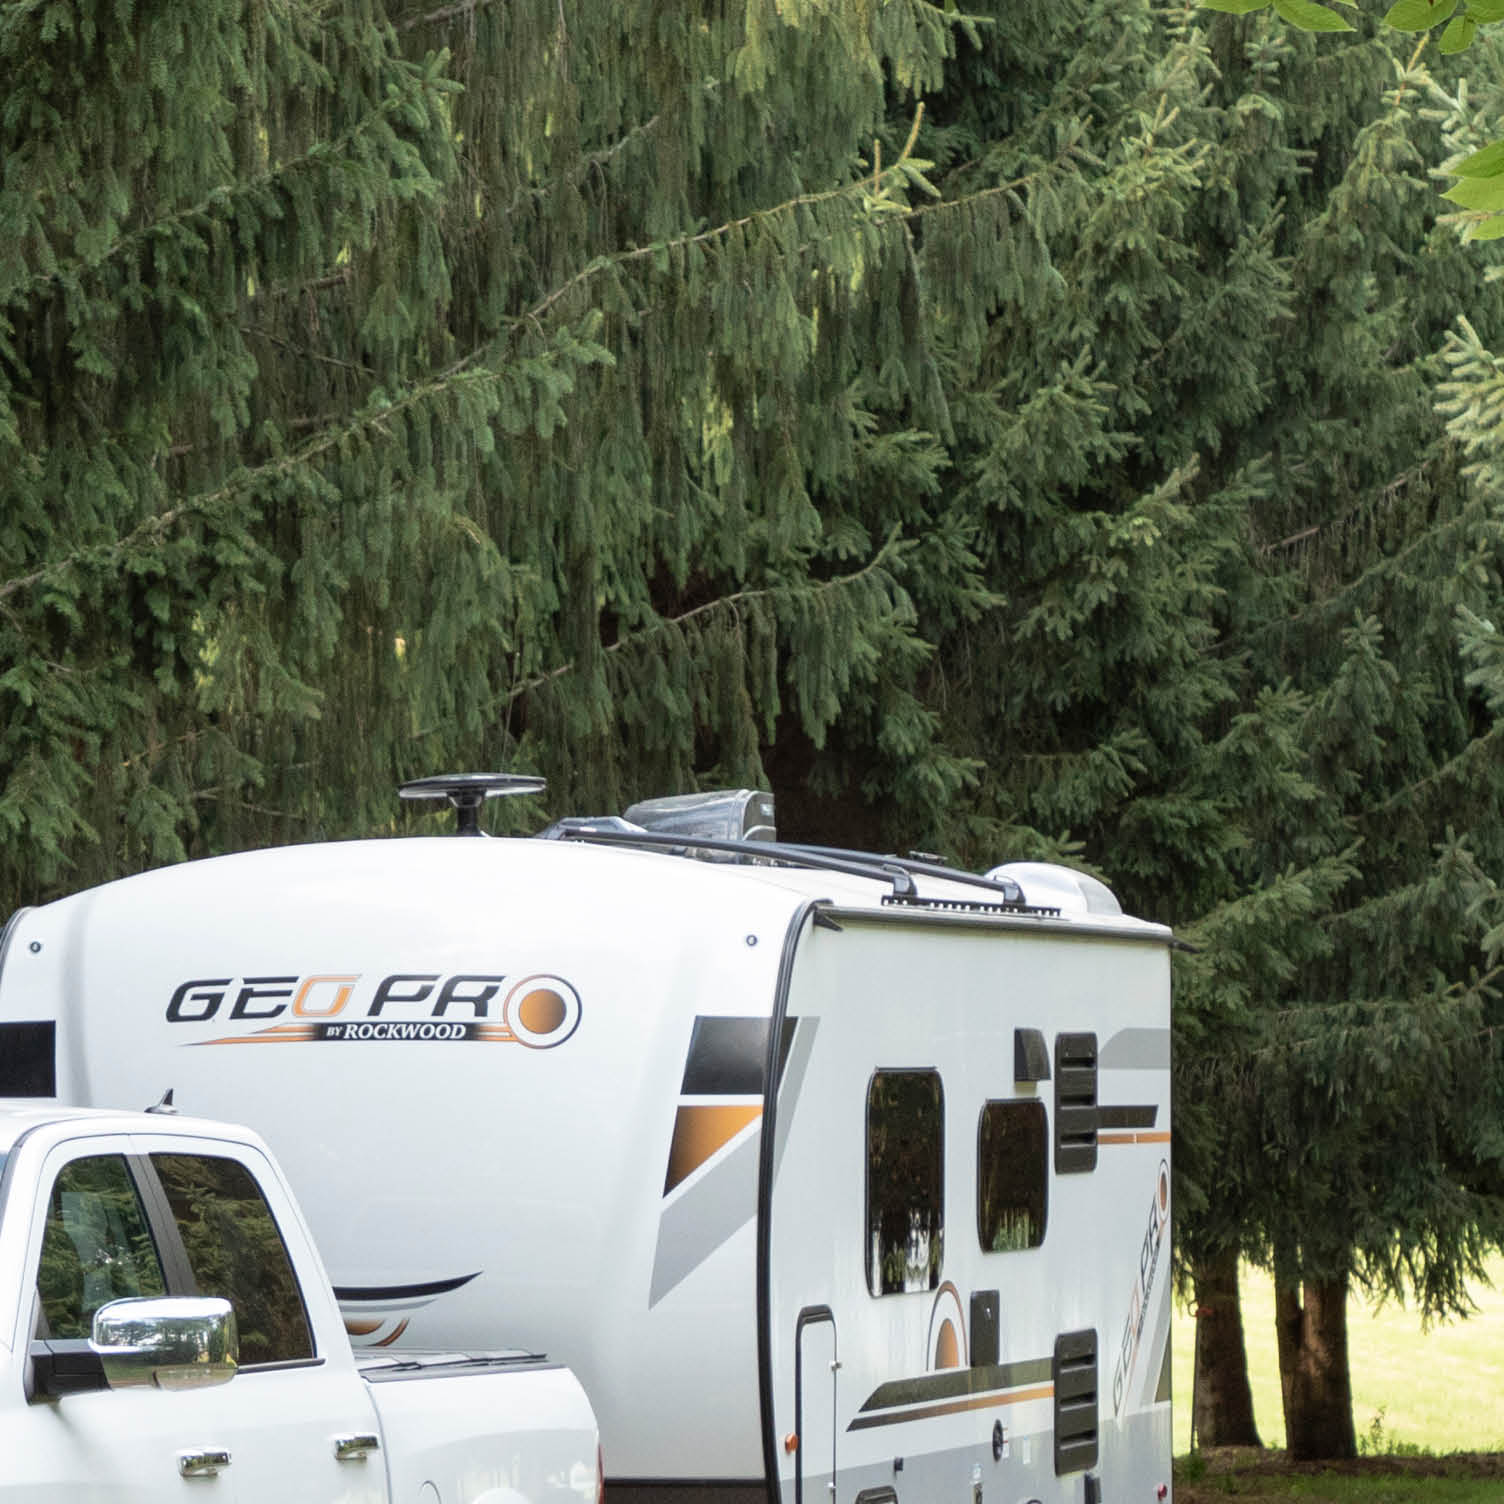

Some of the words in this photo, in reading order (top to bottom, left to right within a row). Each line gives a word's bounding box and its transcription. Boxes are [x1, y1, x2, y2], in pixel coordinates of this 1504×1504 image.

[165, 974, 362, 1023] GEO
[326, 1026, 343, 1038] BY
[344, 1023, 466, 1039] ROCKWOOD
